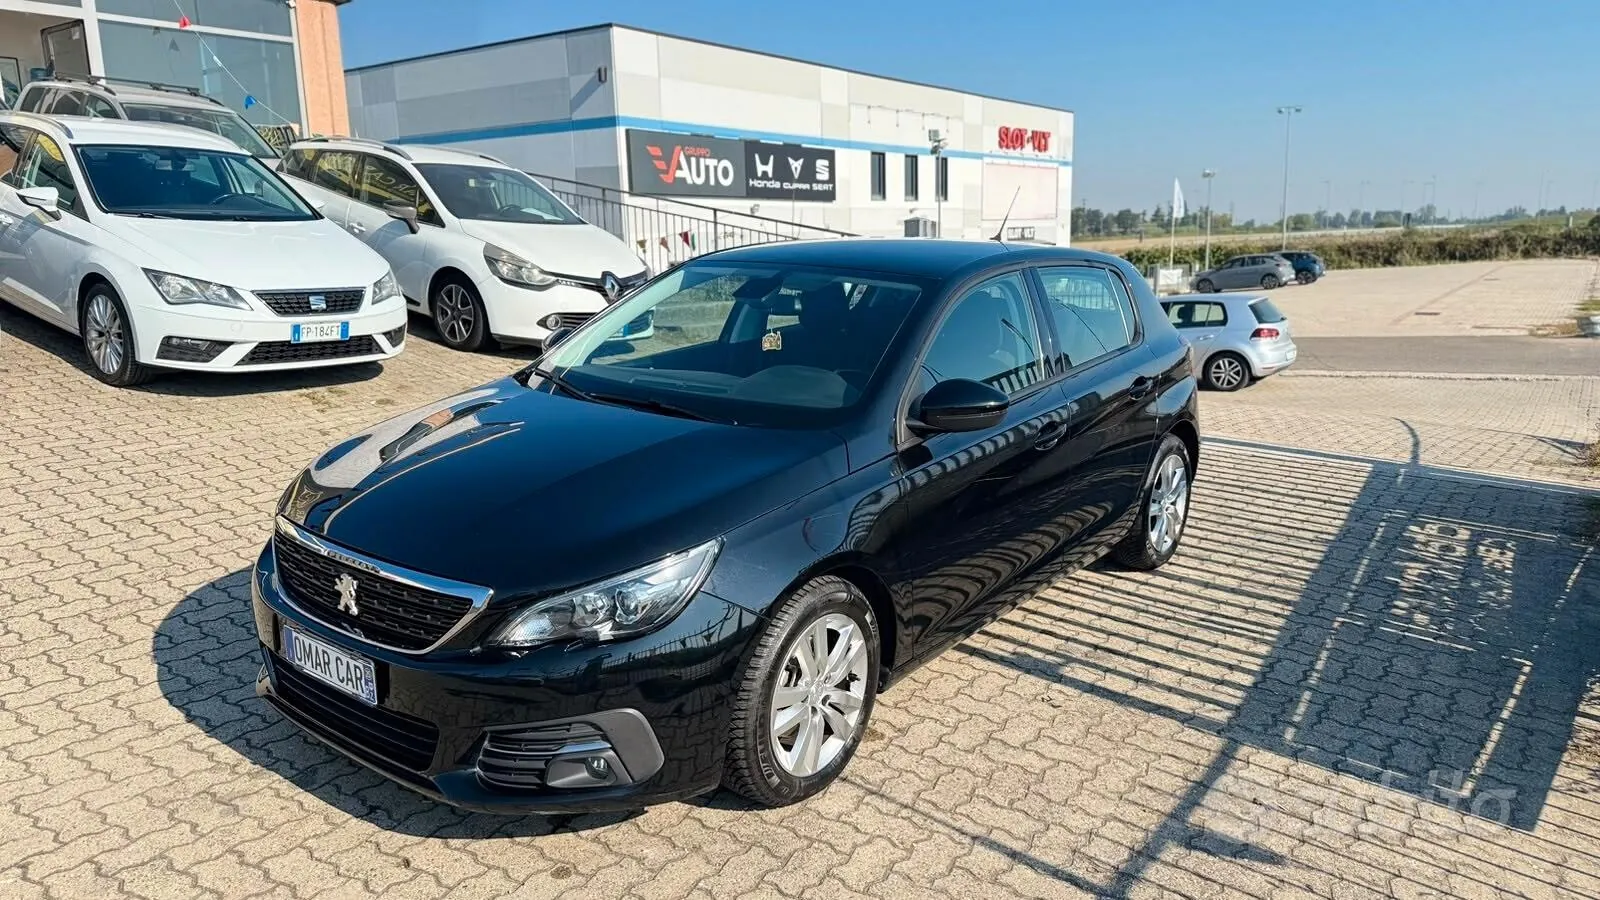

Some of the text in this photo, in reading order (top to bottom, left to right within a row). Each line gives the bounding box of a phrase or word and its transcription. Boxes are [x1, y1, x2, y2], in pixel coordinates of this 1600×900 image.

[684, 146, 711, 157] GRUPPO
[749, 178, 781, 189] Honda
[812, 183, 834, 191] SEAT
[294, 635, 332, 678] OMAR
[335, 657, 365, 694] CAR
